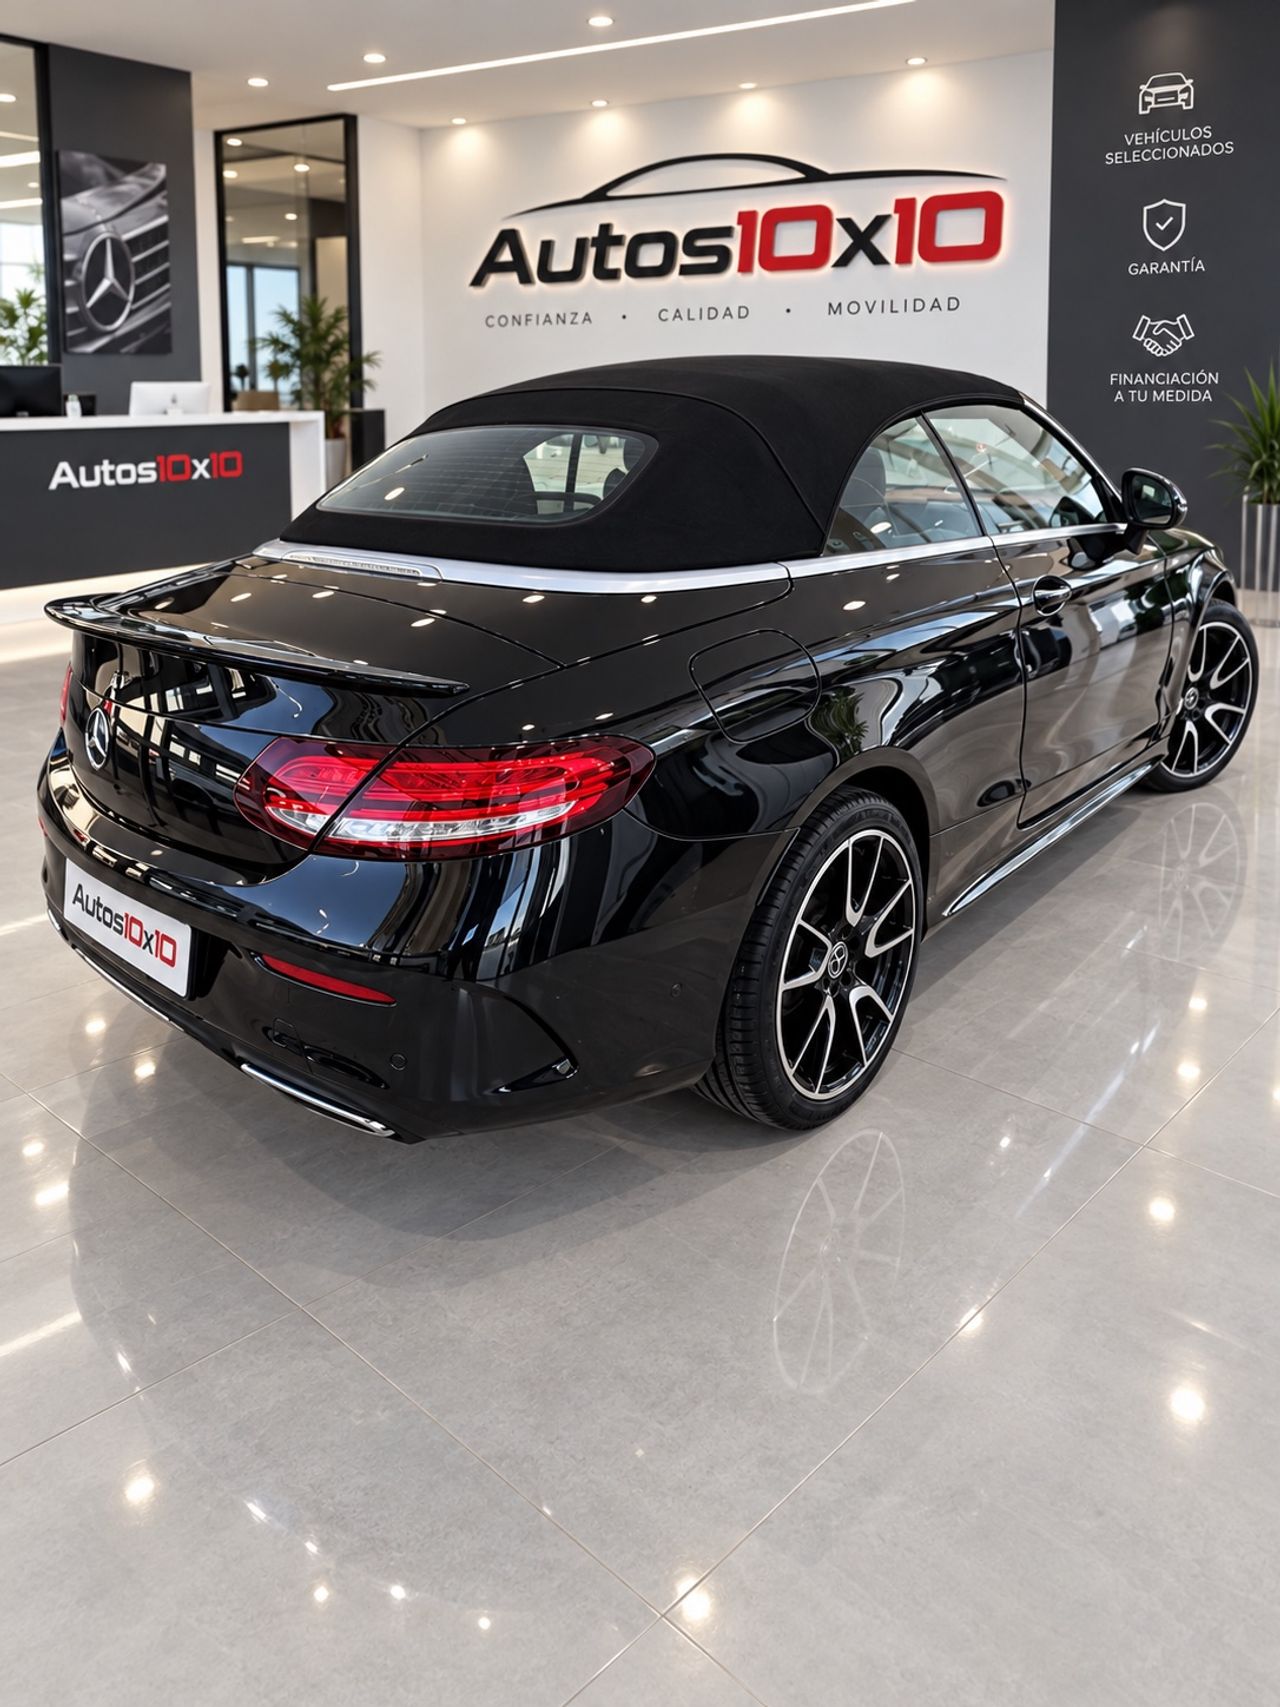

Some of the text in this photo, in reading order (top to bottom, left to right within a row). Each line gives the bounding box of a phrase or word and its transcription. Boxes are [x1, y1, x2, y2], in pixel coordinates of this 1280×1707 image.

[1124, 126, 1213, 147] VEHÍCULOS
[1105, 141, 1235, 165] SELECCIONADOS
[470, 190, 1004, 287] Autos10x10
[1128, 256, 1206, 276] GARANTÍA
[484, 296, 961, 328] CONFIANZA CALIDAD MOVILIDAD
[1110, 369, 1219, 386] FINANCIACIÓN
[1114, 389, 1213, 402] A TU MEDIDA
[49, 450, 243, 490] Autos10x10
[72, 883, 177, 968] Autos10x10
